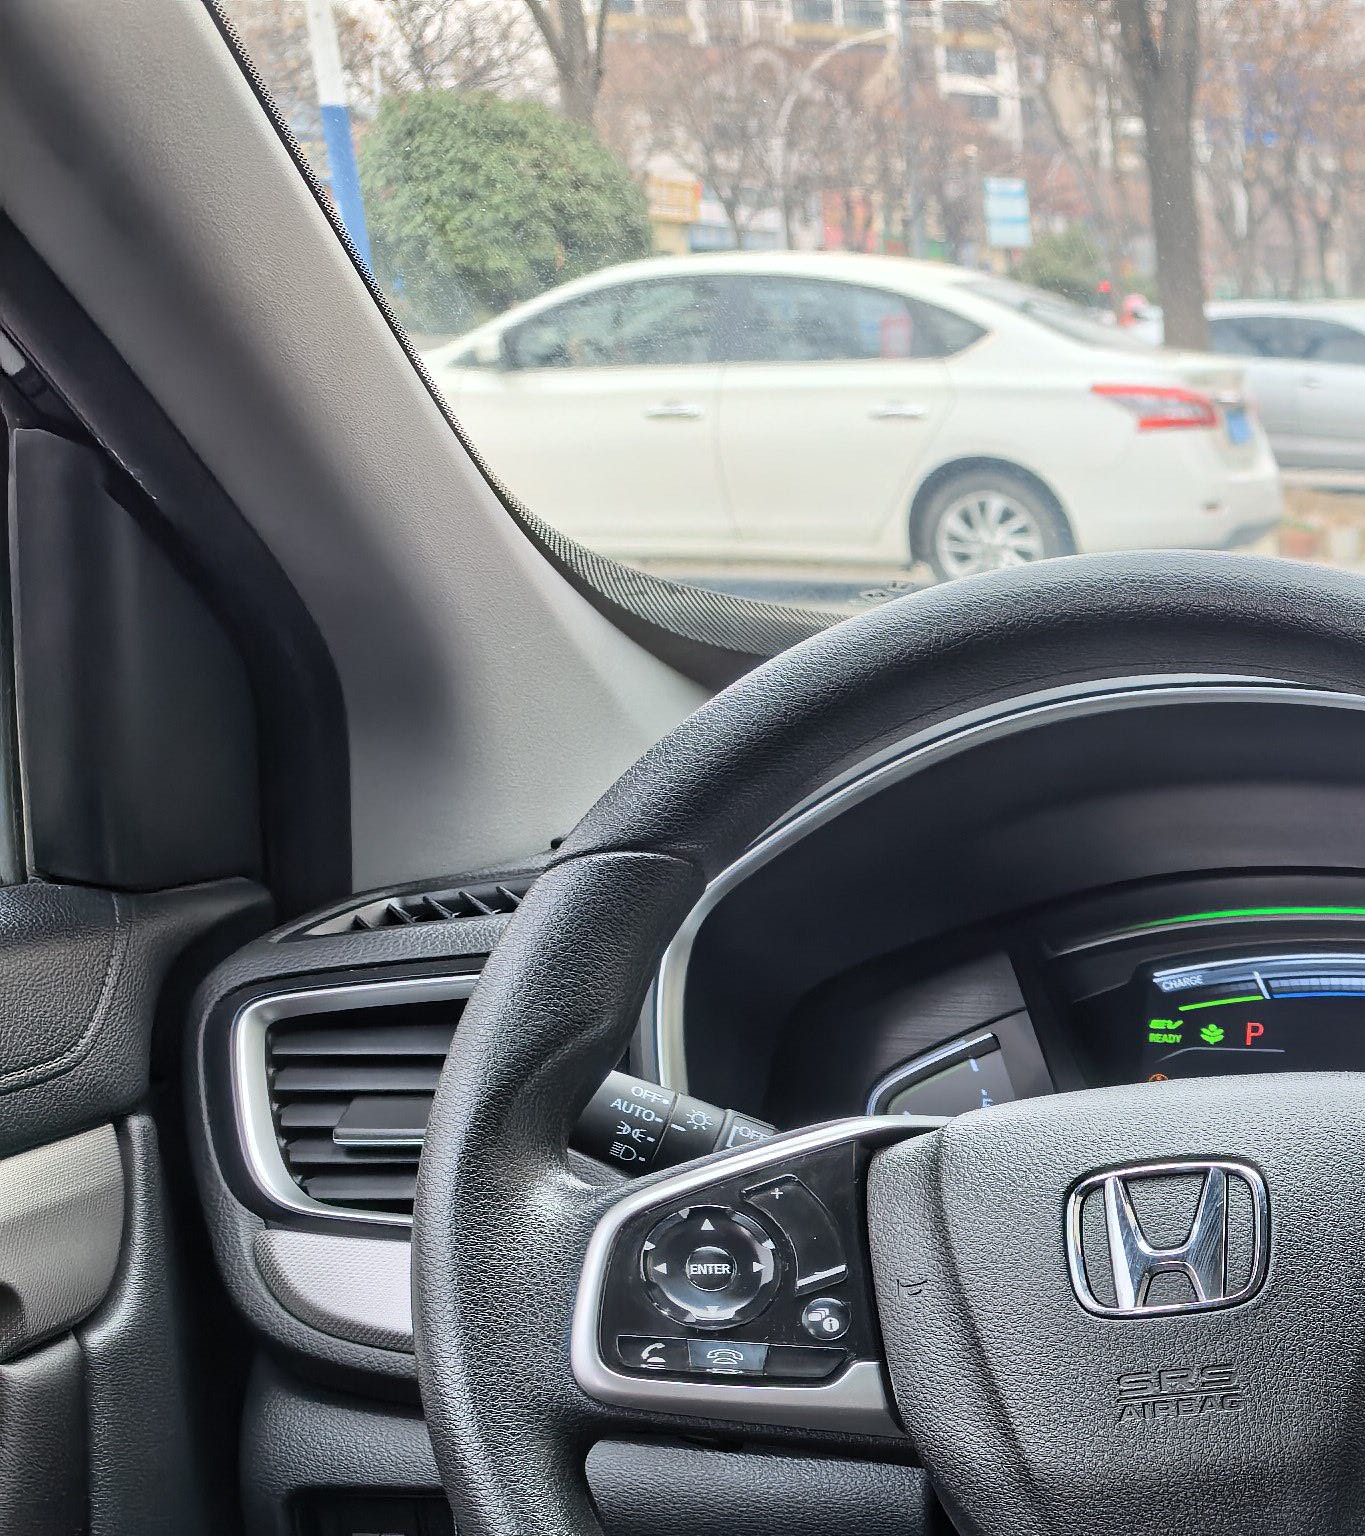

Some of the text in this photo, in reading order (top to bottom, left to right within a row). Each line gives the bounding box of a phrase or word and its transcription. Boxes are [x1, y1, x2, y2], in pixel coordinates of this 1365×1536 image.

[1162, 975, 1203, 991] CHARGE
[1148, 1033, 1182, 1043] READY
[1245, 1022, 1264, 1046] P
[631, 1086, 663, 1103] OFF
[610, 1098, 656, 1123] AUTO
[689, 1263, 732, 1275] ENTER
[1117, 1364, 1238, 1398] SRS
[1118, 1394, 1244, 1422] AIRBAG
